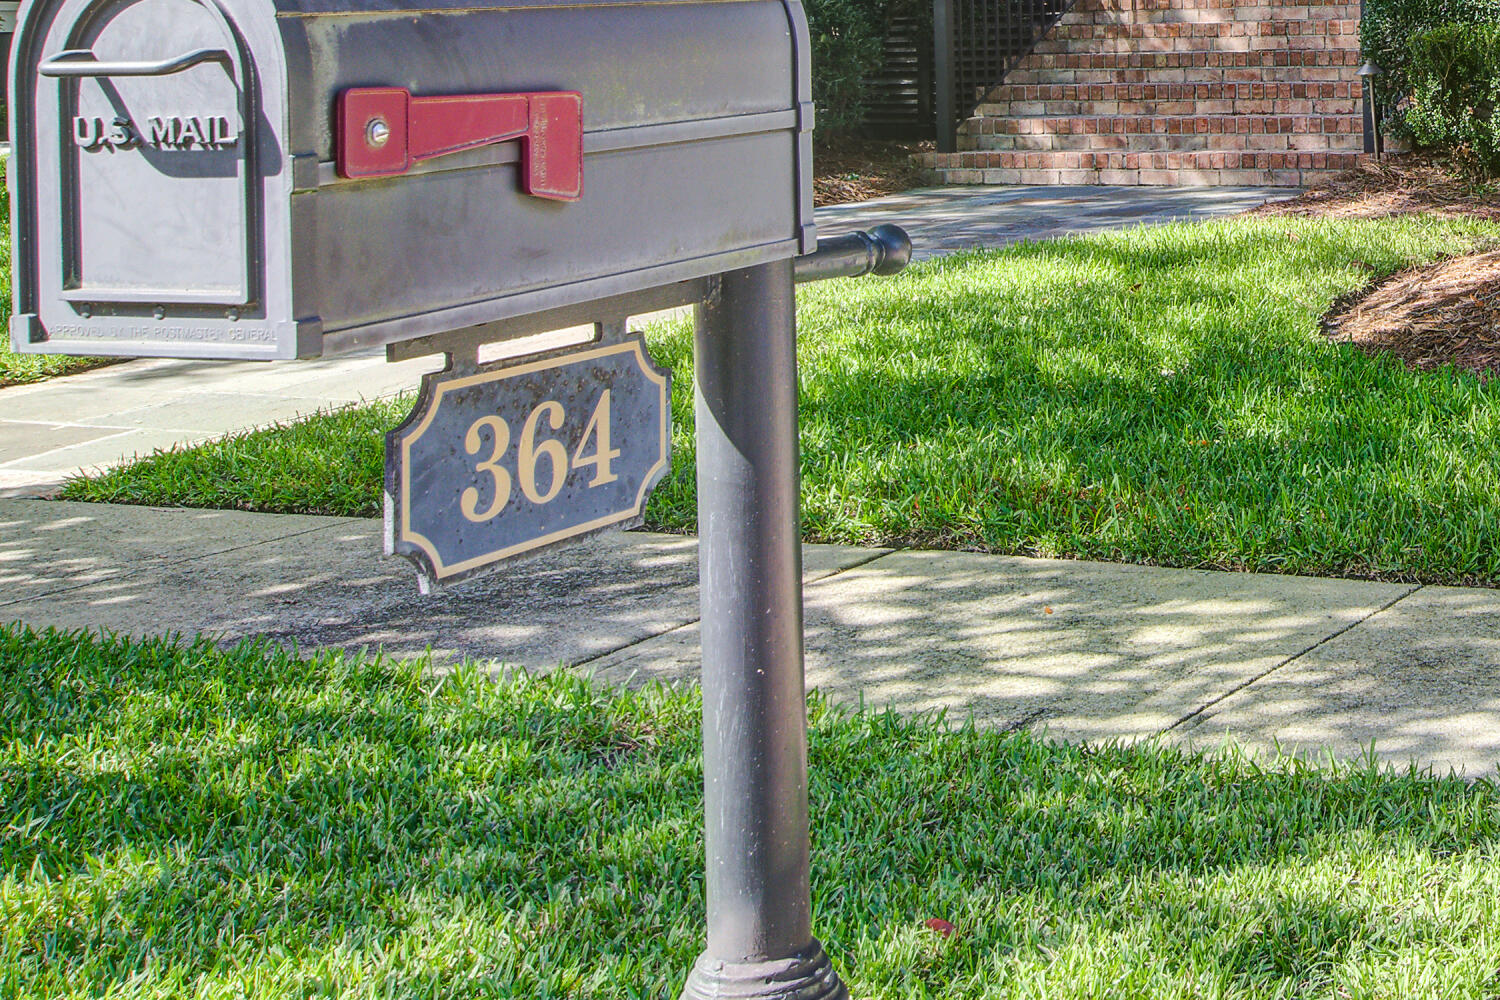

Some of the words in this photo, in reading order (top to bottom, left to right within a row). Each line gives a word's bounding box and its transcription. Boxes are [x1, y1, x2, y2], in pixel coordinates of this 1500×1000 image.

[72, 115, 142, 148] U.S.
[149, 115, 239, 146] MAIL
[48, 324, 105, 338] APPROVED
[111, 326, 125, 338] BY
[128, 326, 149, 339] THE
[153, 326, 224, 340] POSTMASTER
[228, 327, 278, 341] GENERAL
[460, 388, 621, 523] 364
